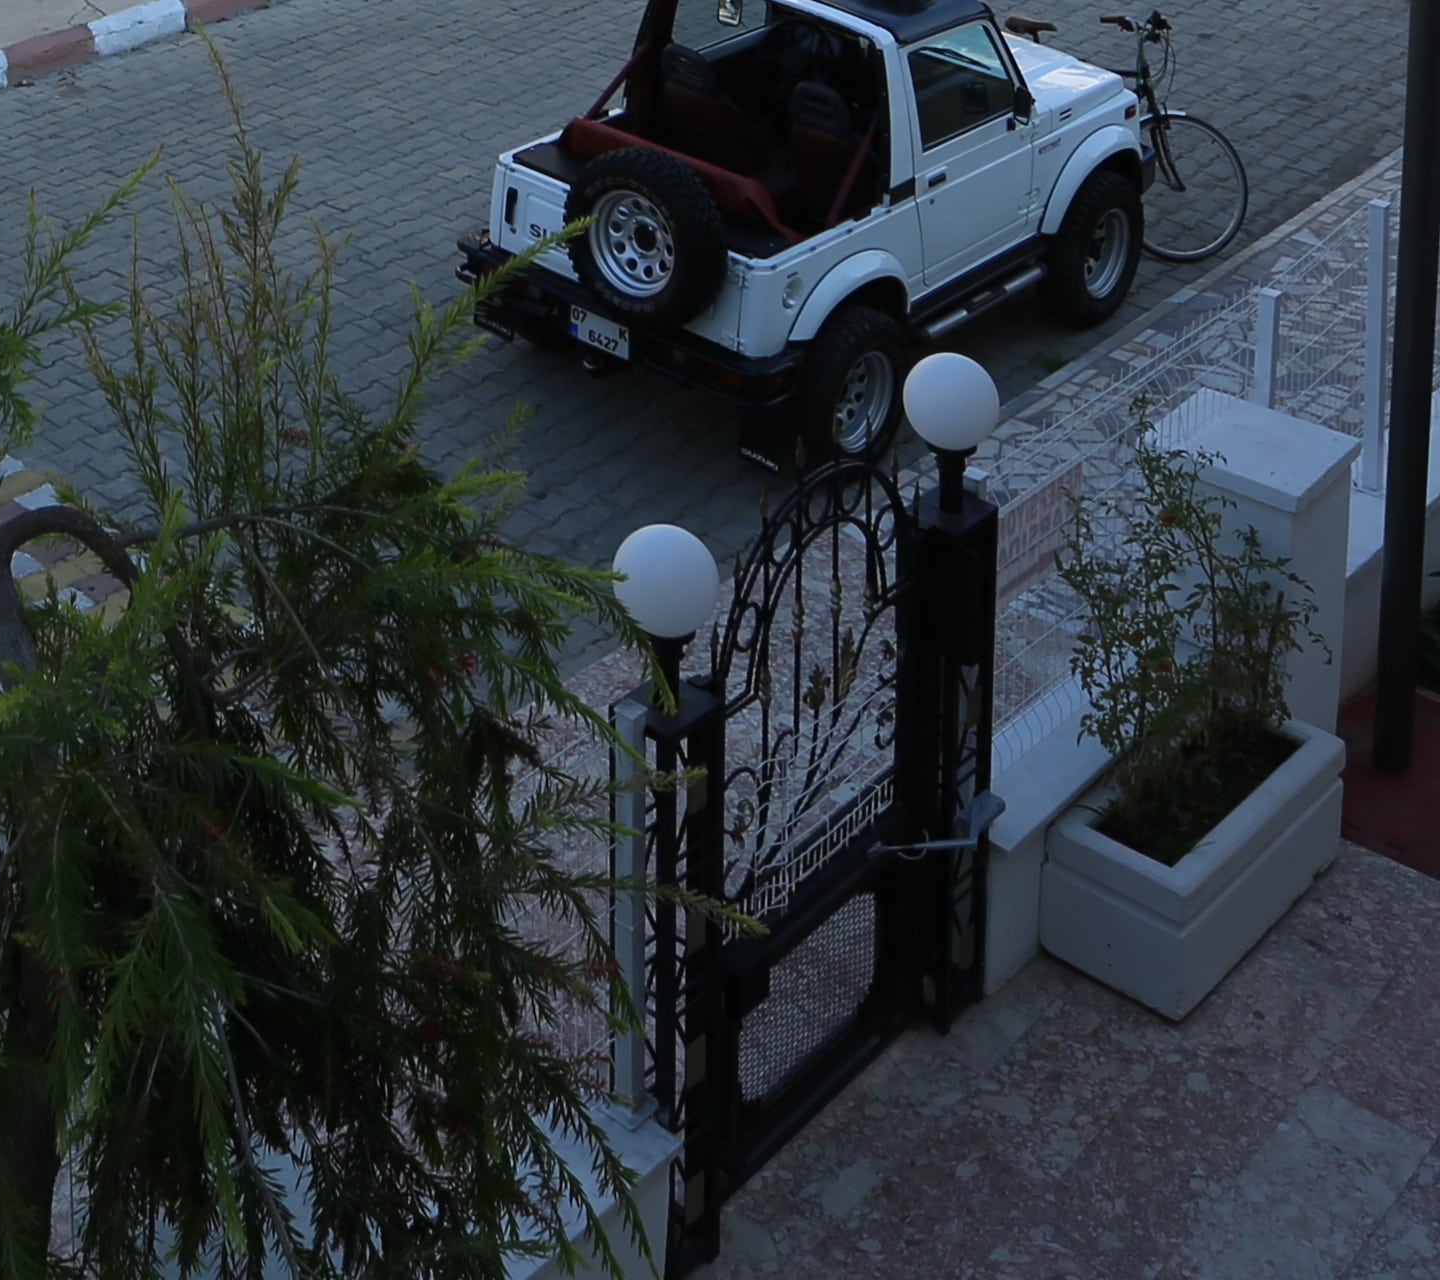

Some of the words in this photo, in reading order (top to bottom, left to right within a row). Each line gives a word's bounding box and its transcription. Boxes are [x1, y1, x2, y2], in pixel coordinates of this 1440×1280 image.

[572, 308, 587, 323] 07
[618, 327, 627, 342] K
[588, 329, 619, 352] 6427
